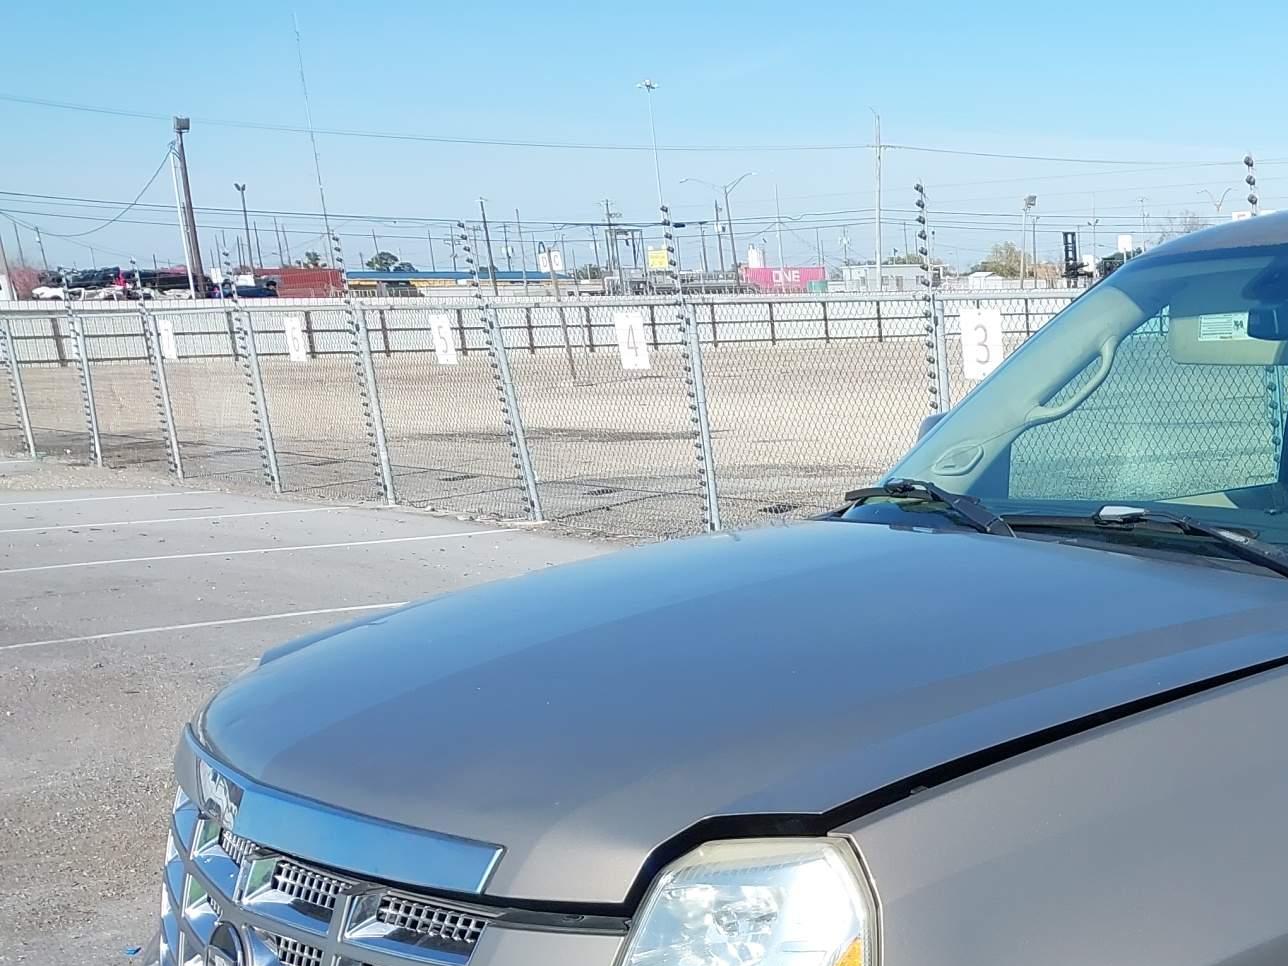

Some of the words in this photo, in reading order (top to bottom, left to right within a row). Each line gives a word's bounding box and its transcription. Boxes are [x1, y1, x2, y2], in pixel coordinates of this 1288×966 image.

[290, 326, 300, 353] 6
[437, 325, 449, 353] 5
[626, 324, 640, 357] 4
[973, 323, 991, 365] 3
